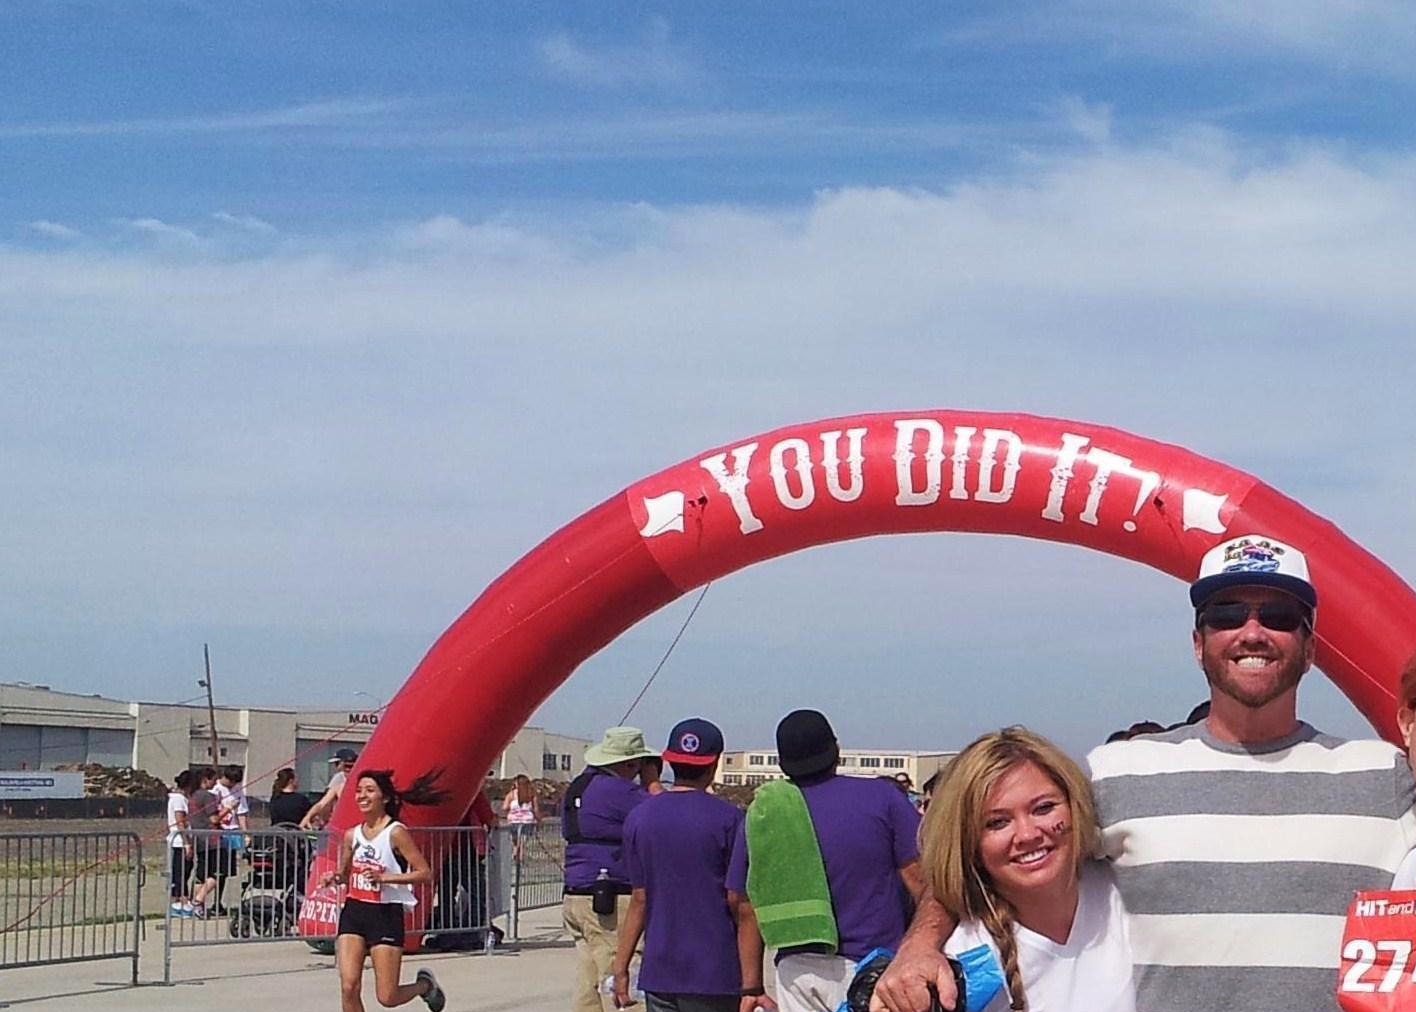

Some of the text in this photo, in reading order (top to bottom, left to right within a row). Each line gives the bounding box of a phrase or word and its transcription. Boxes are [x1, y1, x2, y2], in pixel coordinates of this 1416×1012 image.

[700, 427, 868, 535] YOU
[891, 418, 1022, 506] DID
[1355, 899, 1388, 917] HIT
[1387, 901, 1415, 915] and
